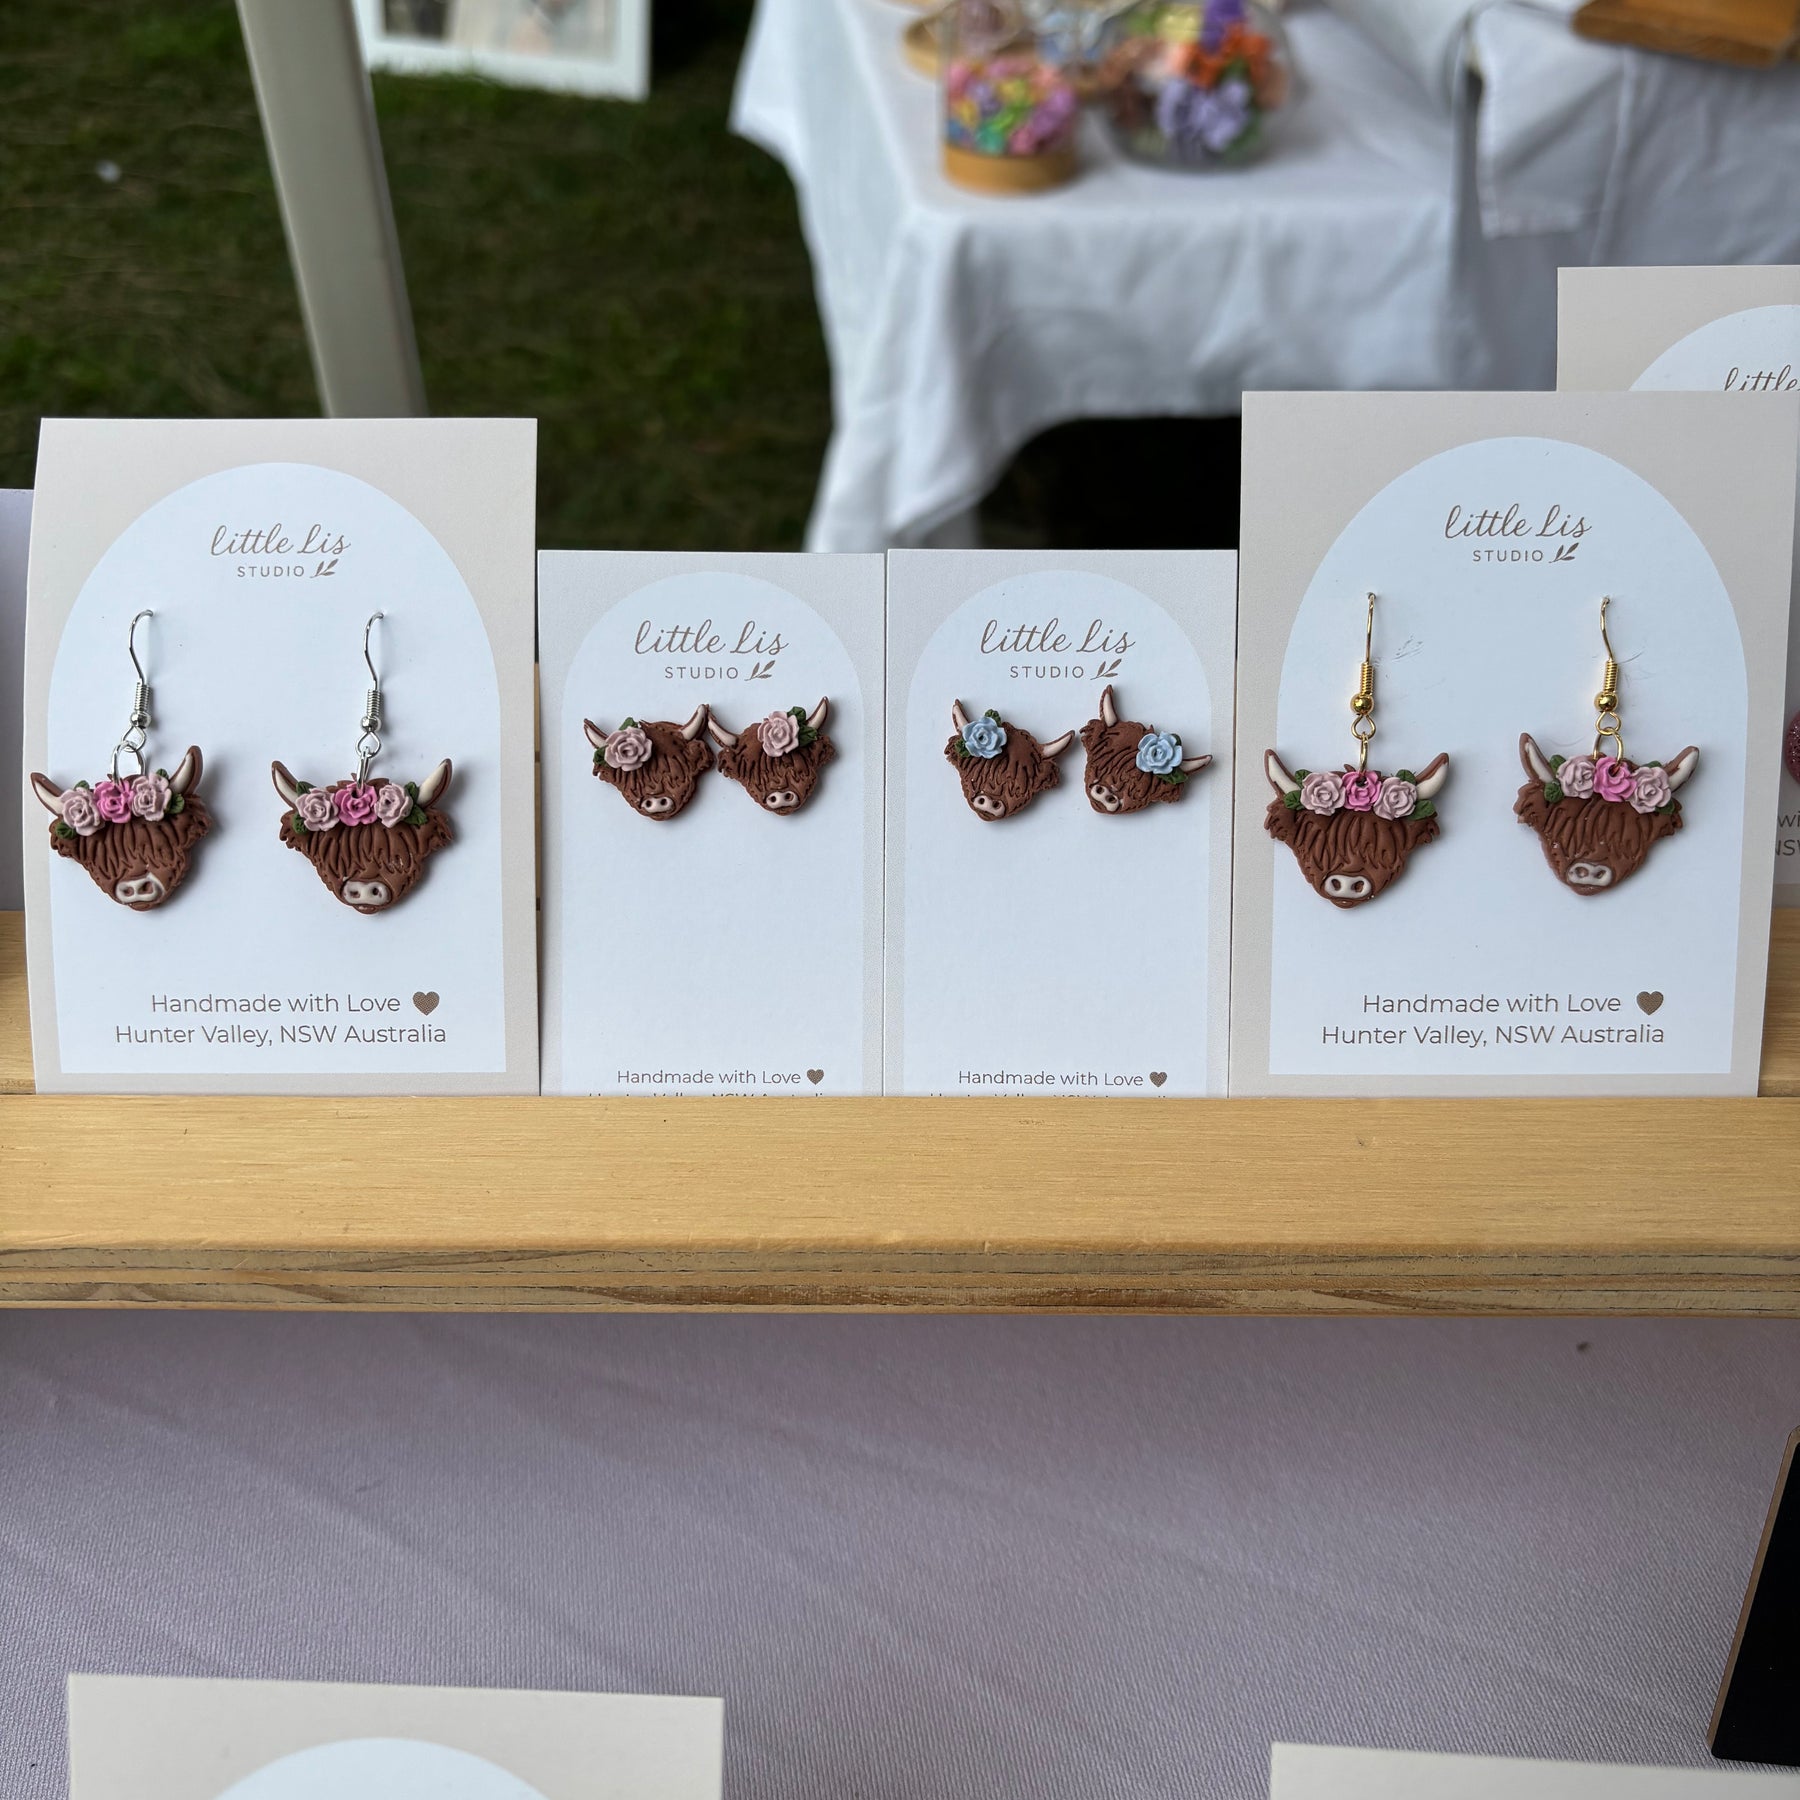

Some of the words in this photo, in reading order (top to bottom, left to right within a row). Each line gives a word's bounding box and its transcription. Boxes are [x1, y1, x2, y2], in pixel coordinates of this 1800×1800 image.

[1445, 503, 1532, 538] little
[1535, 504, 1592, 538] Lis
[210, 523, 294, 556] little
[297, 524, 351, 555] Lis
[1472, 550, 1544, 562] STUDIO
[237, 565, 305, 578] STUDIO
[634, 619, 725, 655] little
[730, 620, 789, 655] Lis
[980, 618, 1072, 654] little
[1076, 619, 1136, 654] Lis
[665, 666, 738, 680] STUDIO
[1010, 665, 1084, 679] STUDIO
[152, 993, 281, 1013] Handmade
[288, 993, 339, 1013] with
[347, 994, 401, 1012] Love
[1363, 994, 1499, 1013] Handmade
[1506, 993, 1559, 1013] with
[1568, 994, 1621, 1012] Love
[116, 1025, 195, 1044] Hunter
[201, 1024, 272, 1047] Valley,
[280, 1025, 337, 1043] NSW
[344, 1023, 446, 1043] Australia
[1323, 1025, 1407, 1045] Hunter
[1413, 1025, 1487, 1048] Valley,
[1496, 1025, 1555, 1043] NSW
[1561, 1023, 1664, 1043] Australia
[617, 1069, 714, 1084] Handmade
[719, 1069, 756, 1084] with
[762, 1070, 801, 1084] Love
[958, 1070, 1055, 1086] Handmade
[1060, 1071, 1098, 1086] with
[1104, 1072, 1143, 1086] Love
